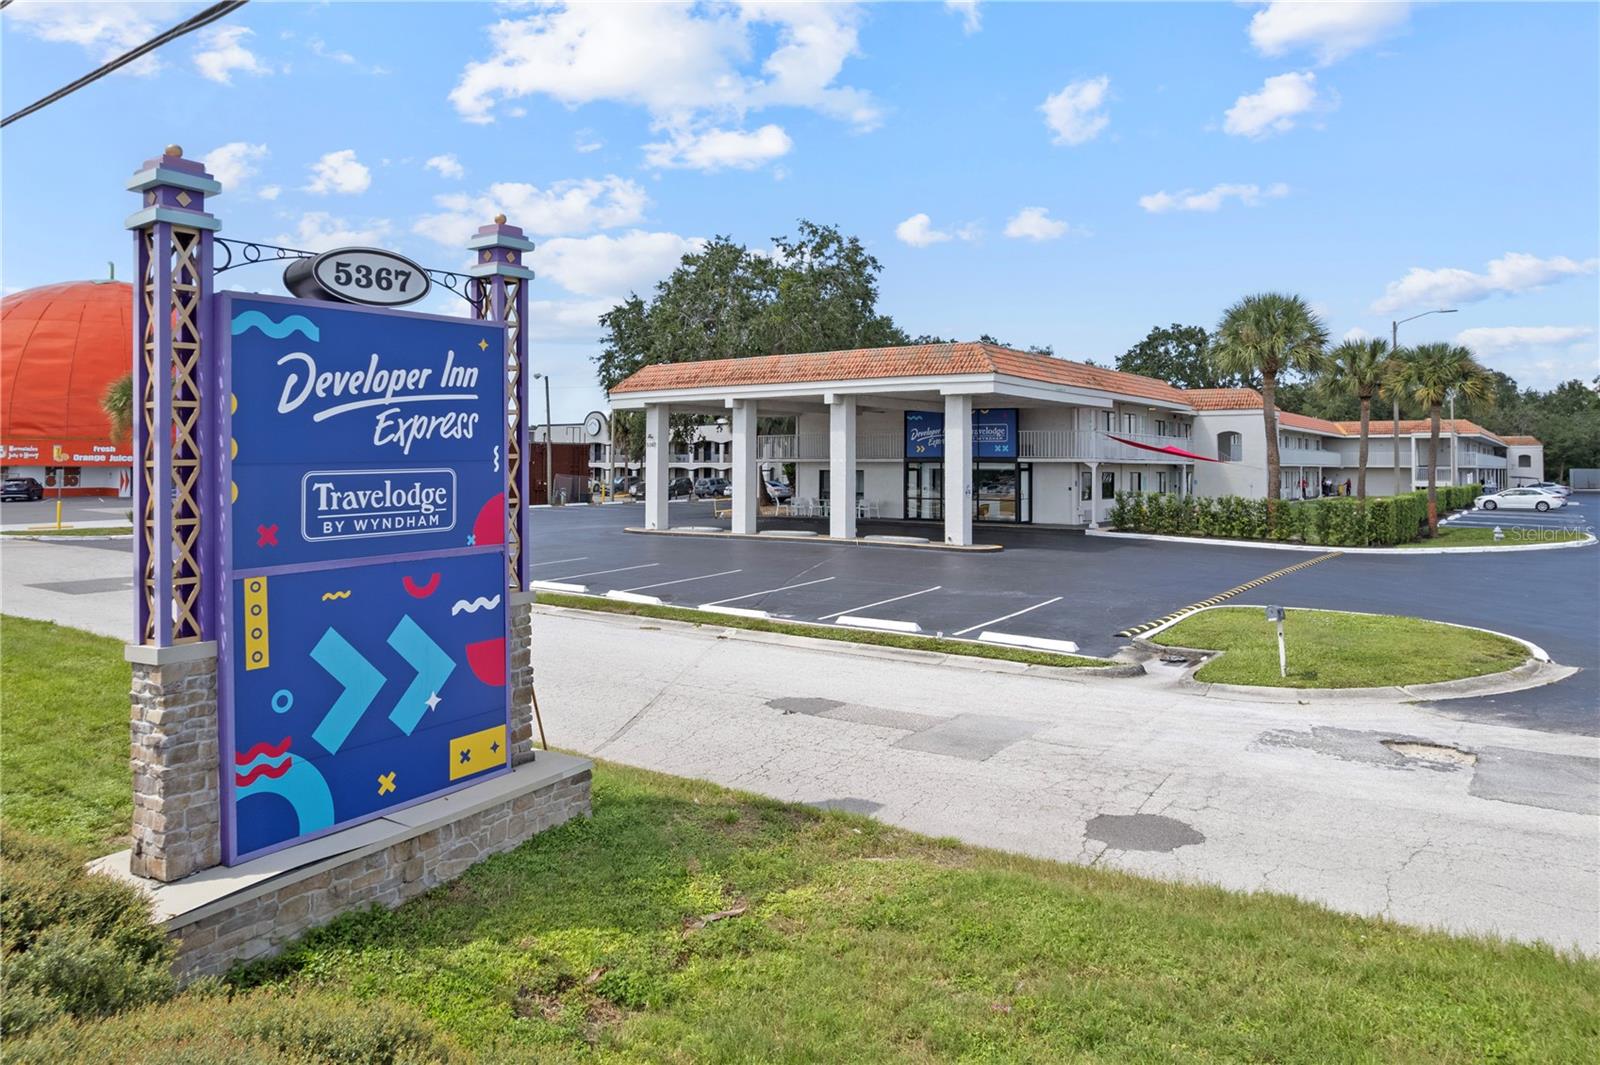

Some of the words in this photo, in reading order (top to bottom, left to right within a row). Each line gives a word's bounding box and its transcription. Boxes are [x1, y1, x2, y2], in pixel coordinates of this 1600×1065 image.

[334, 261, 412, 293] 5367
[277, 352, 432, 414] Developer
[440, 350, 479, 388] Inn
[373, 407, 479, 455] Express
[109, 454, 133, 462] Juice
[312, 480, 448, 513] Travelodge
[323, 521, 345, 534] BY
[353, 514, 440, 532] WYNDHAM
